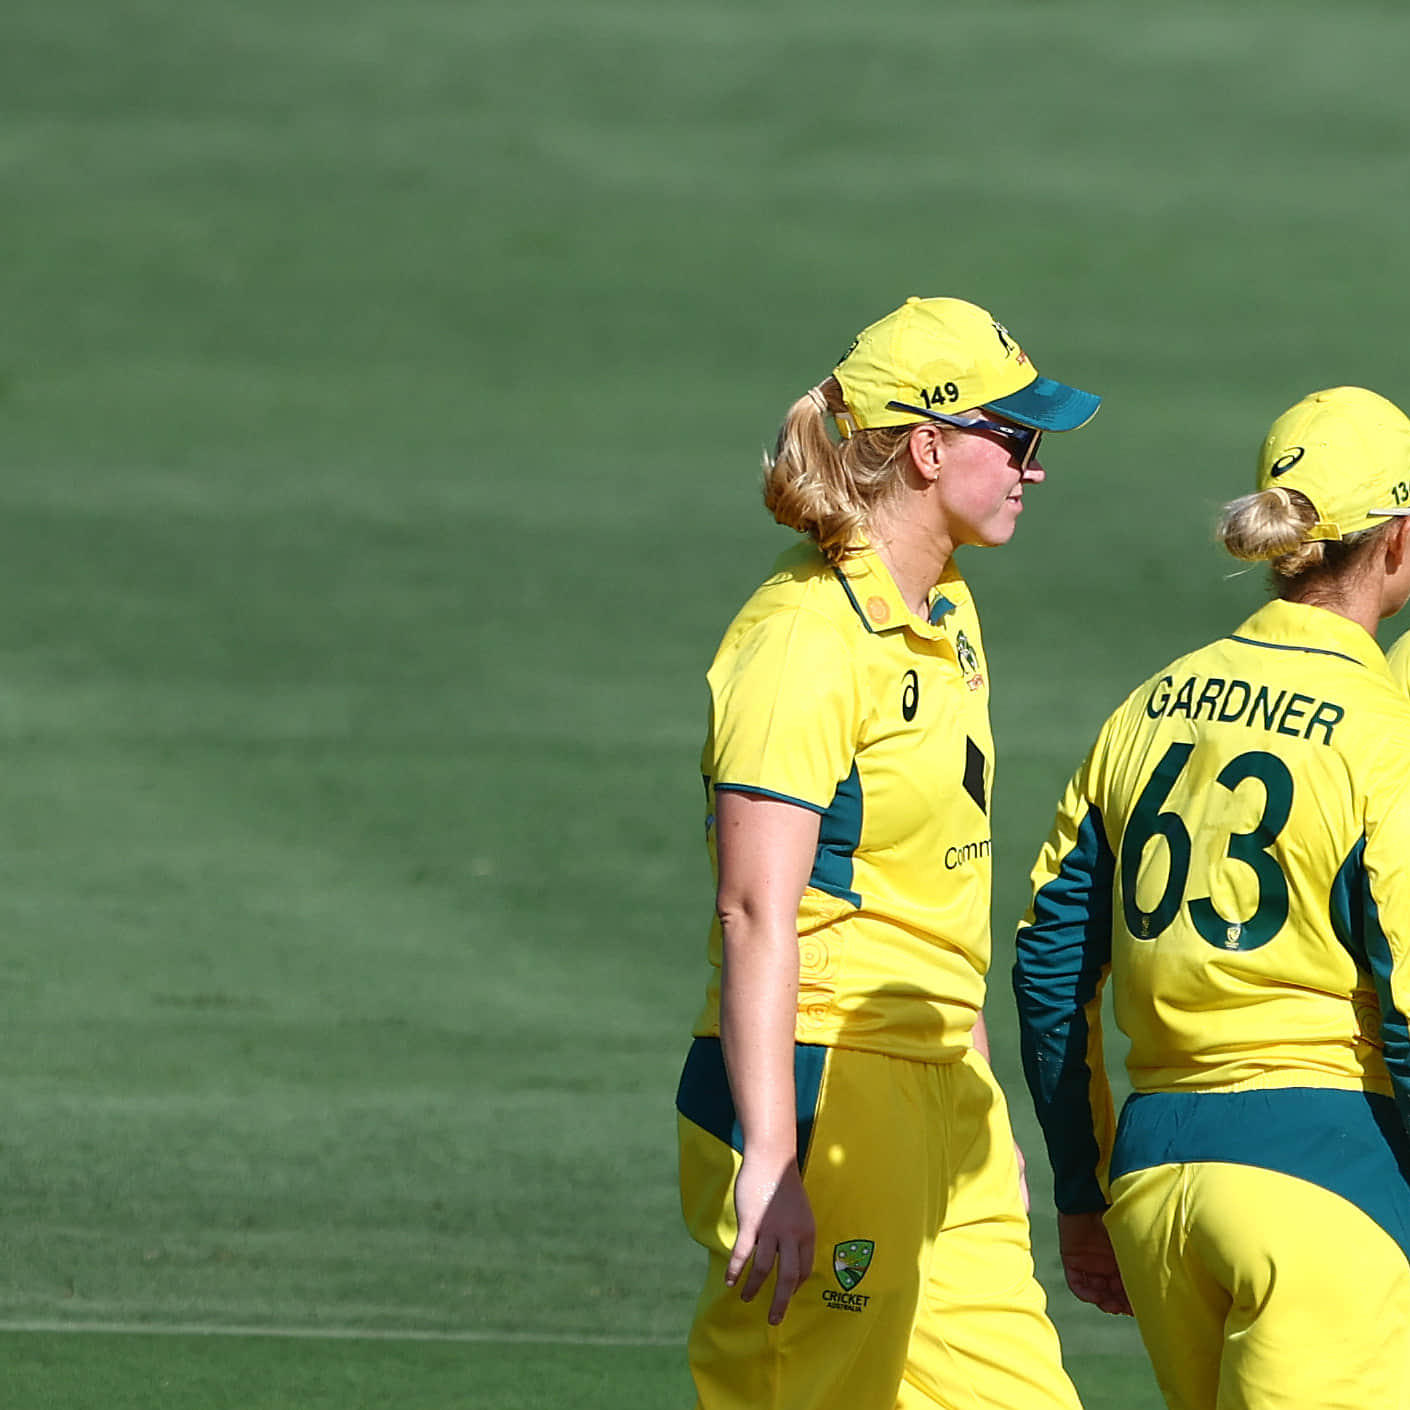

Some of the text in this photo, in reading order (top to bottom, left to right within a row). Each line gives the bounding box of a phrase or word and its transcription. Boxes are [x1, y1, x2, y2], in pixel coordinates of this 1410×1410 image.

[920, 382, 959, 409] 149
[1147, 676, 1346, 746] GARDNER
[1121, 742, 1295, 951] 63
[822, 1290, 871, 1307] CRICKET
